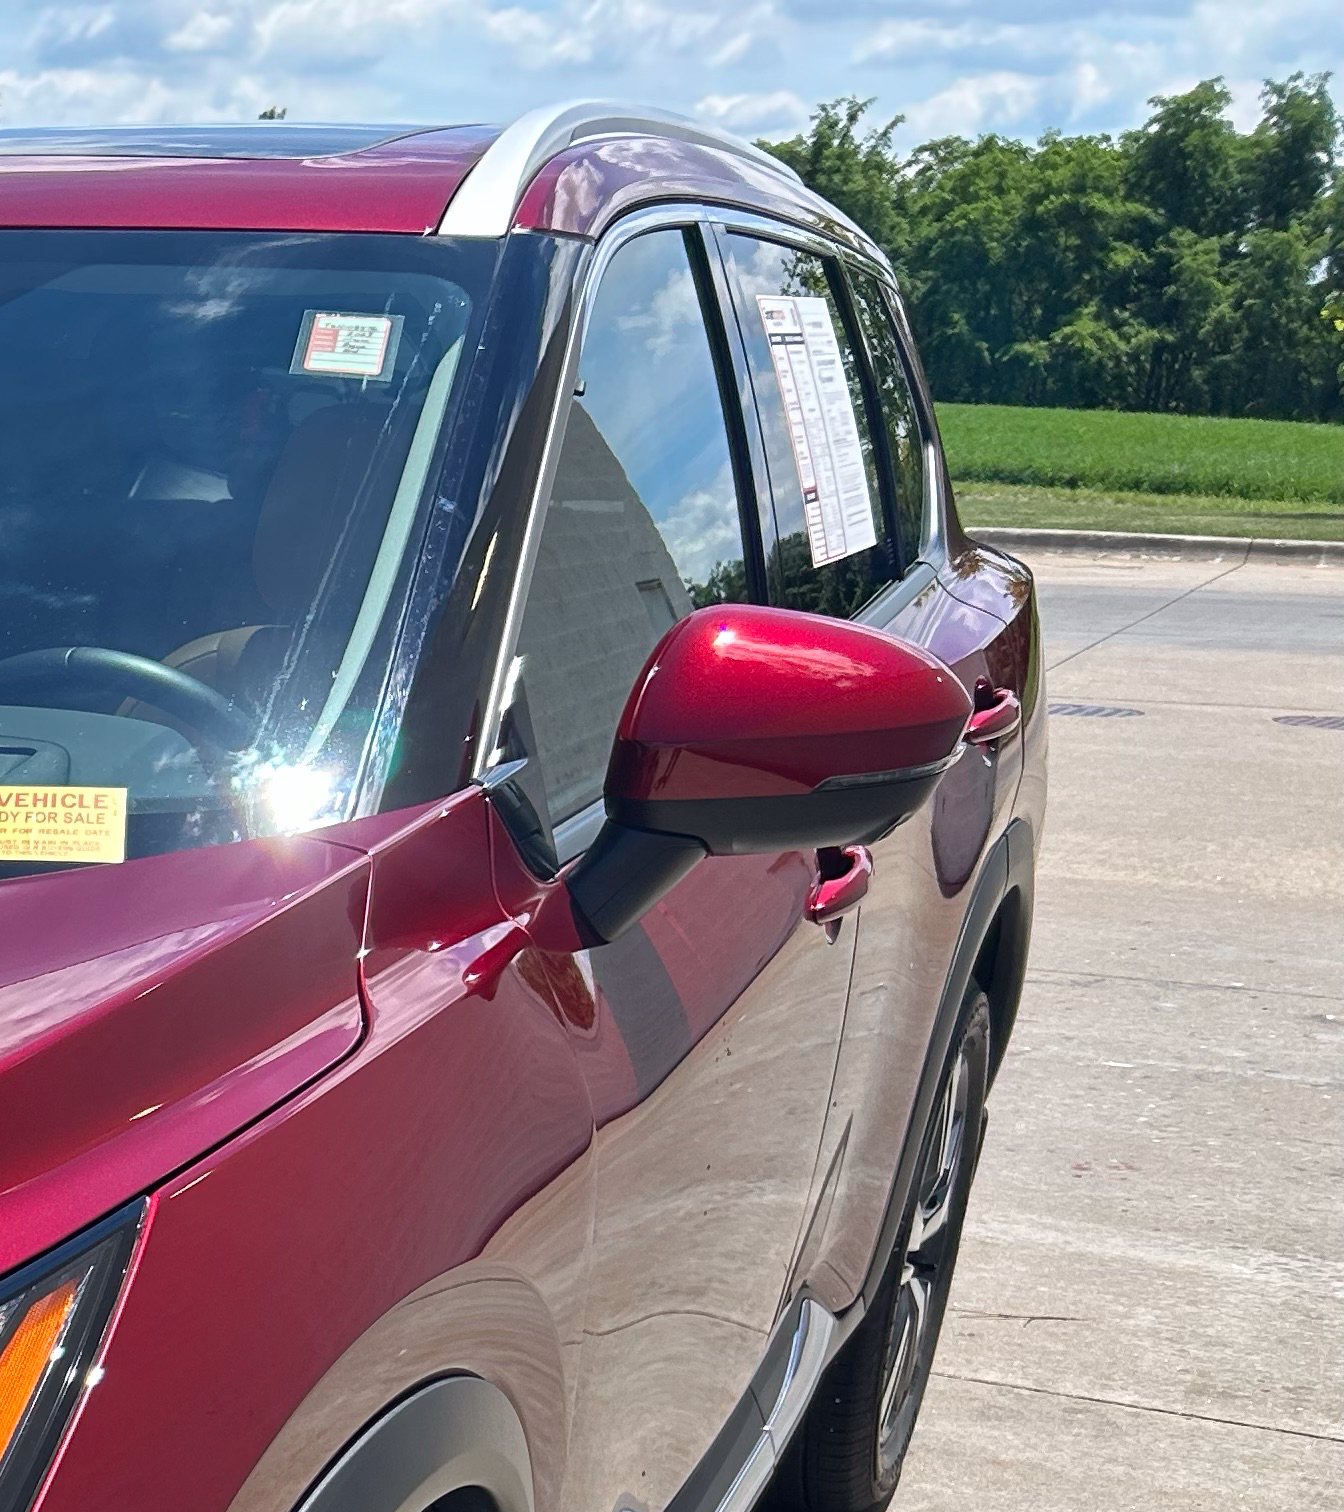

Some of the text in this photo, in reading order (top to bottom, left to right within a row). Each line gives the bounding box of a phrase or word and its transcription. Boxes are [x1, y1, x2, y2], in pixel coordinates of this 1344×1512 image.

[25, 811, 58, 824] FOR
[64, 812, 106, 825] SALE
[38, 828, 79, 836] RESALE
